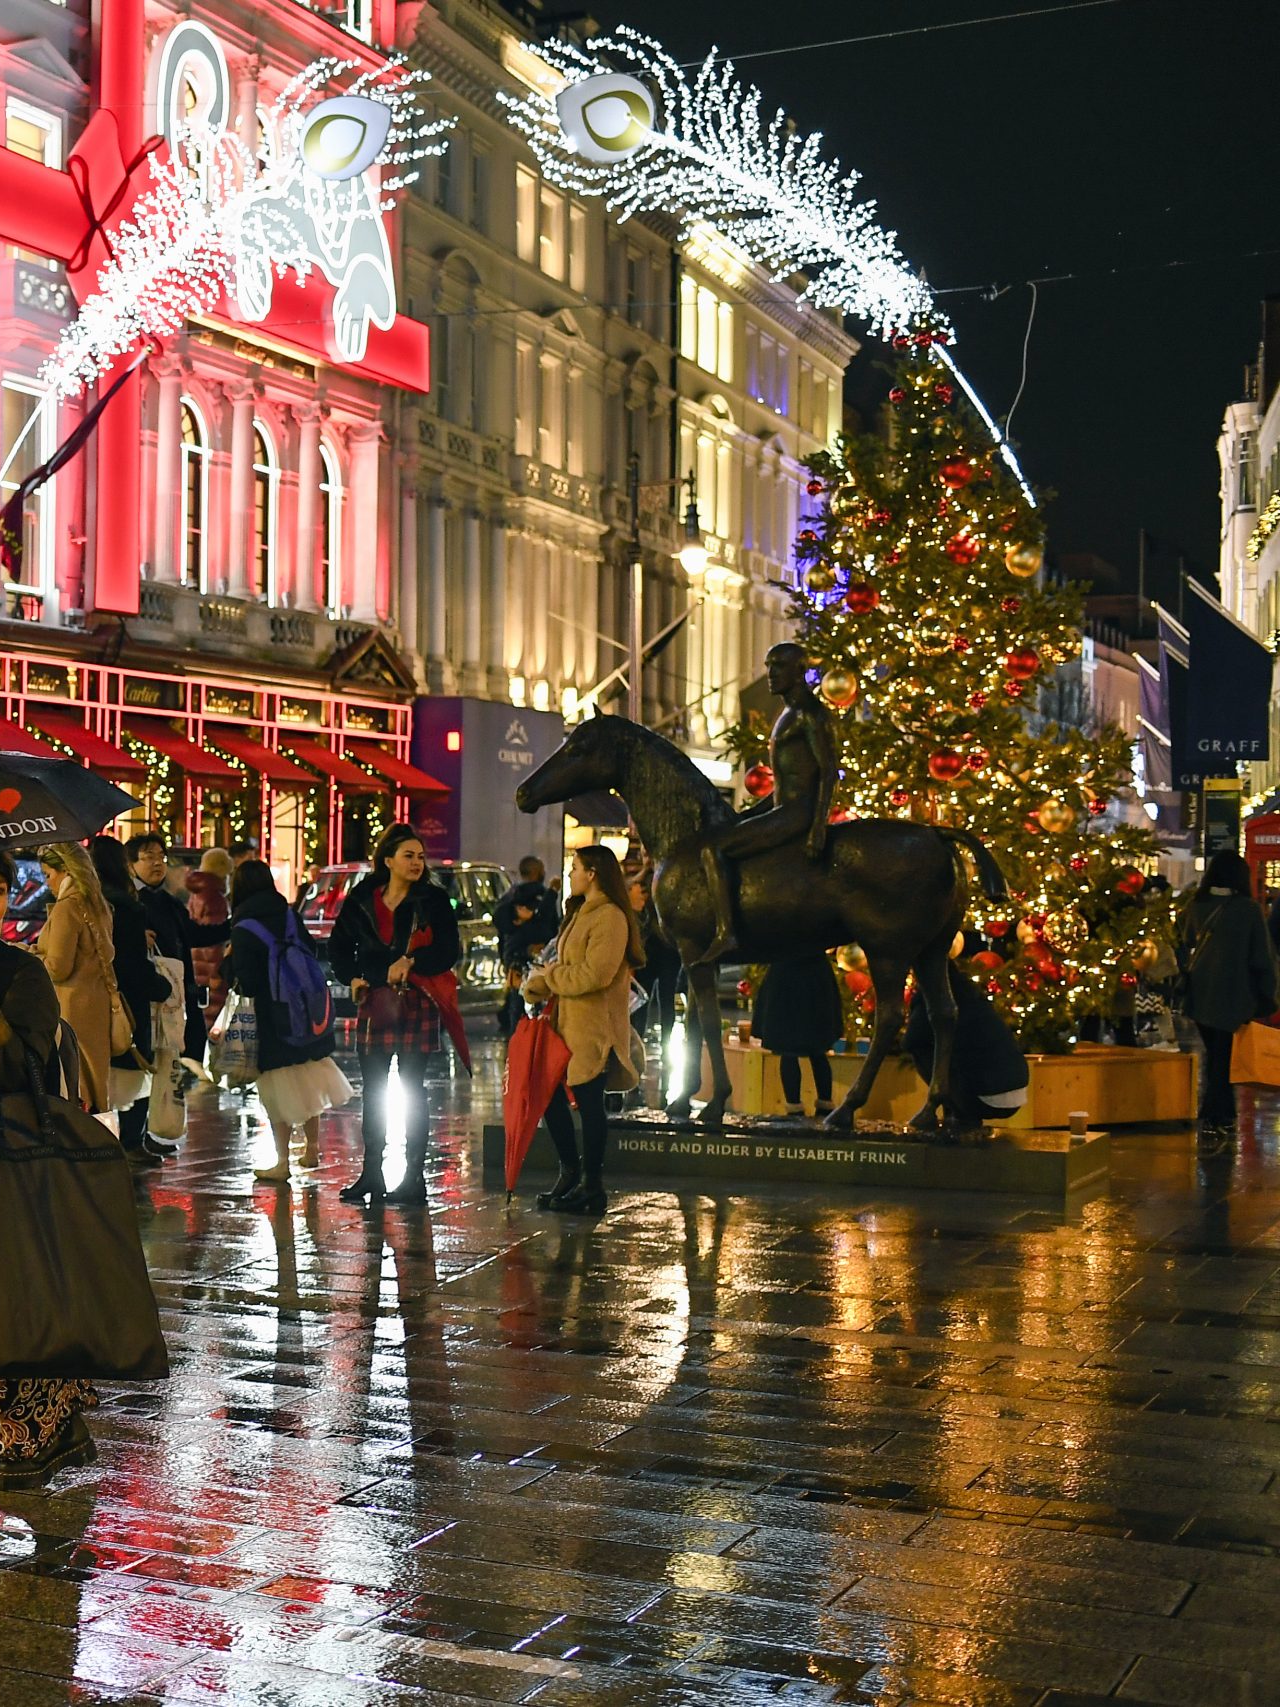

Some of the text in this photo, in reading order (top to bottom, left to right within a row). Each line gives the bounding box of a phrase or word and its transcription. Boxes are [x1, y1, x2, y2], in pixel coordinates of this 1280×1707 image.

[124, 682, 160, 704] Cartier
[1198, 739, 1261, 752] GRAFF
[619, 1140, 907, 1164] HORSE AND RIDER BY ELISABETH FRINK
